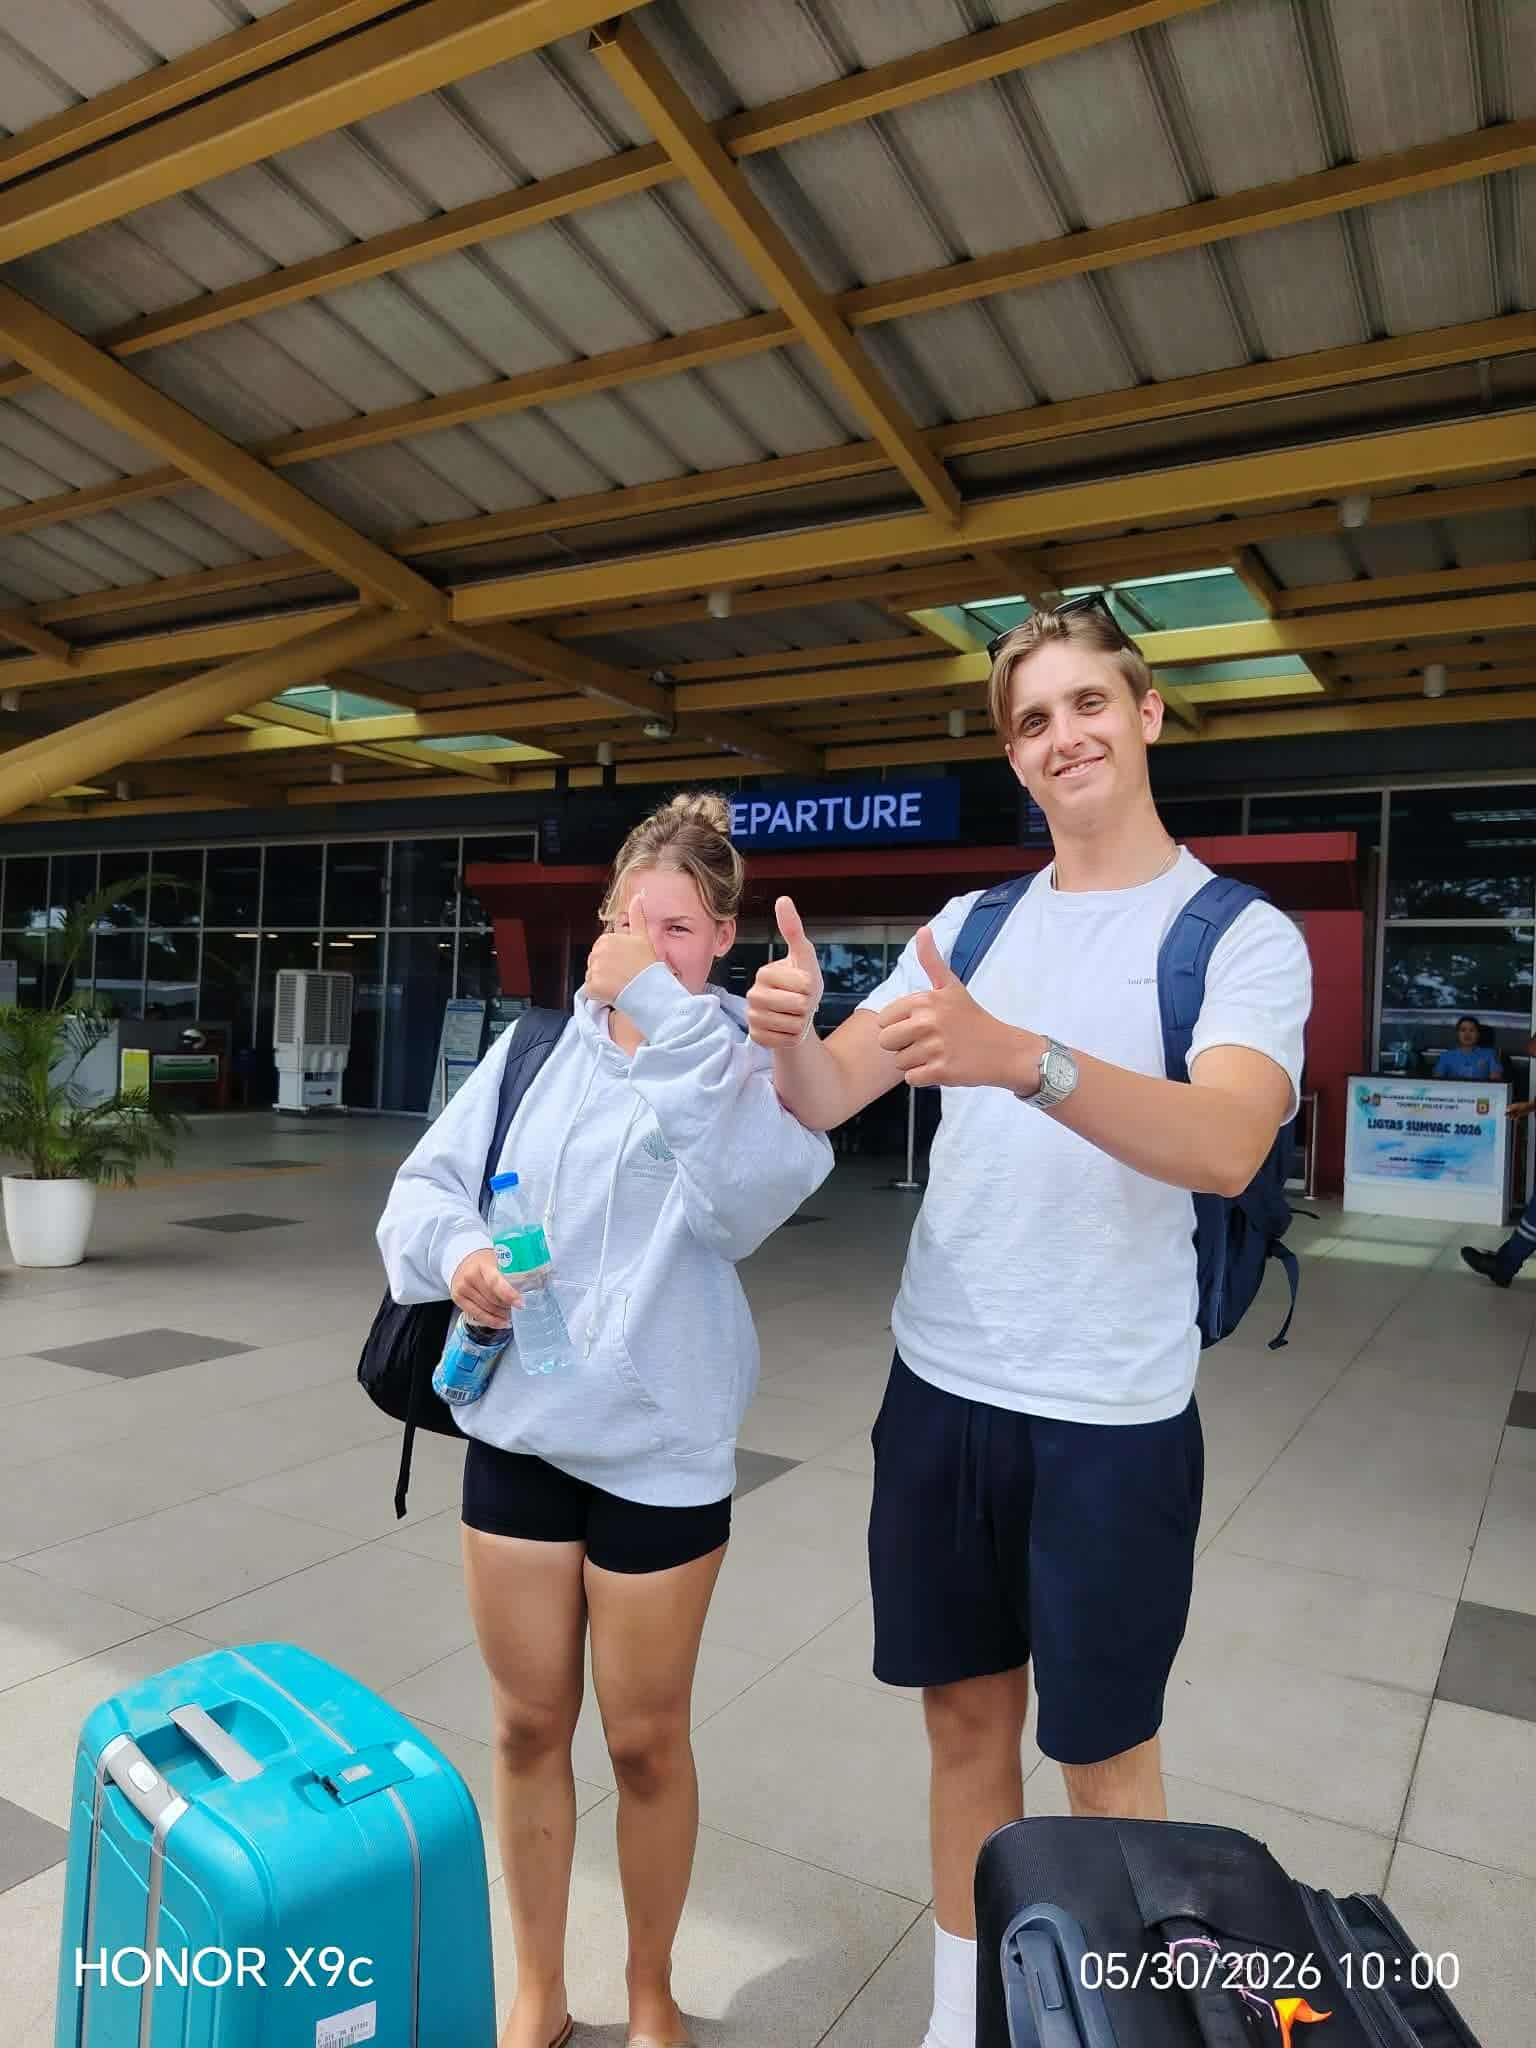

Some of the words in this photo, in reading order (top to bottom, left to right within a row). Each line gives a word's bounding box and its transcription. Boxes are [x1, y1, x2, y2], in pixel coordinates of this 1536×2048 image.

[730, 792, 922, 835] EPARTURE
[1367, 1118, 1403, 1131] LIGTAS
[1406, 1119, 1451, 1134] SUMVAC
[1454, 1123, 1482, 1136] 2026
